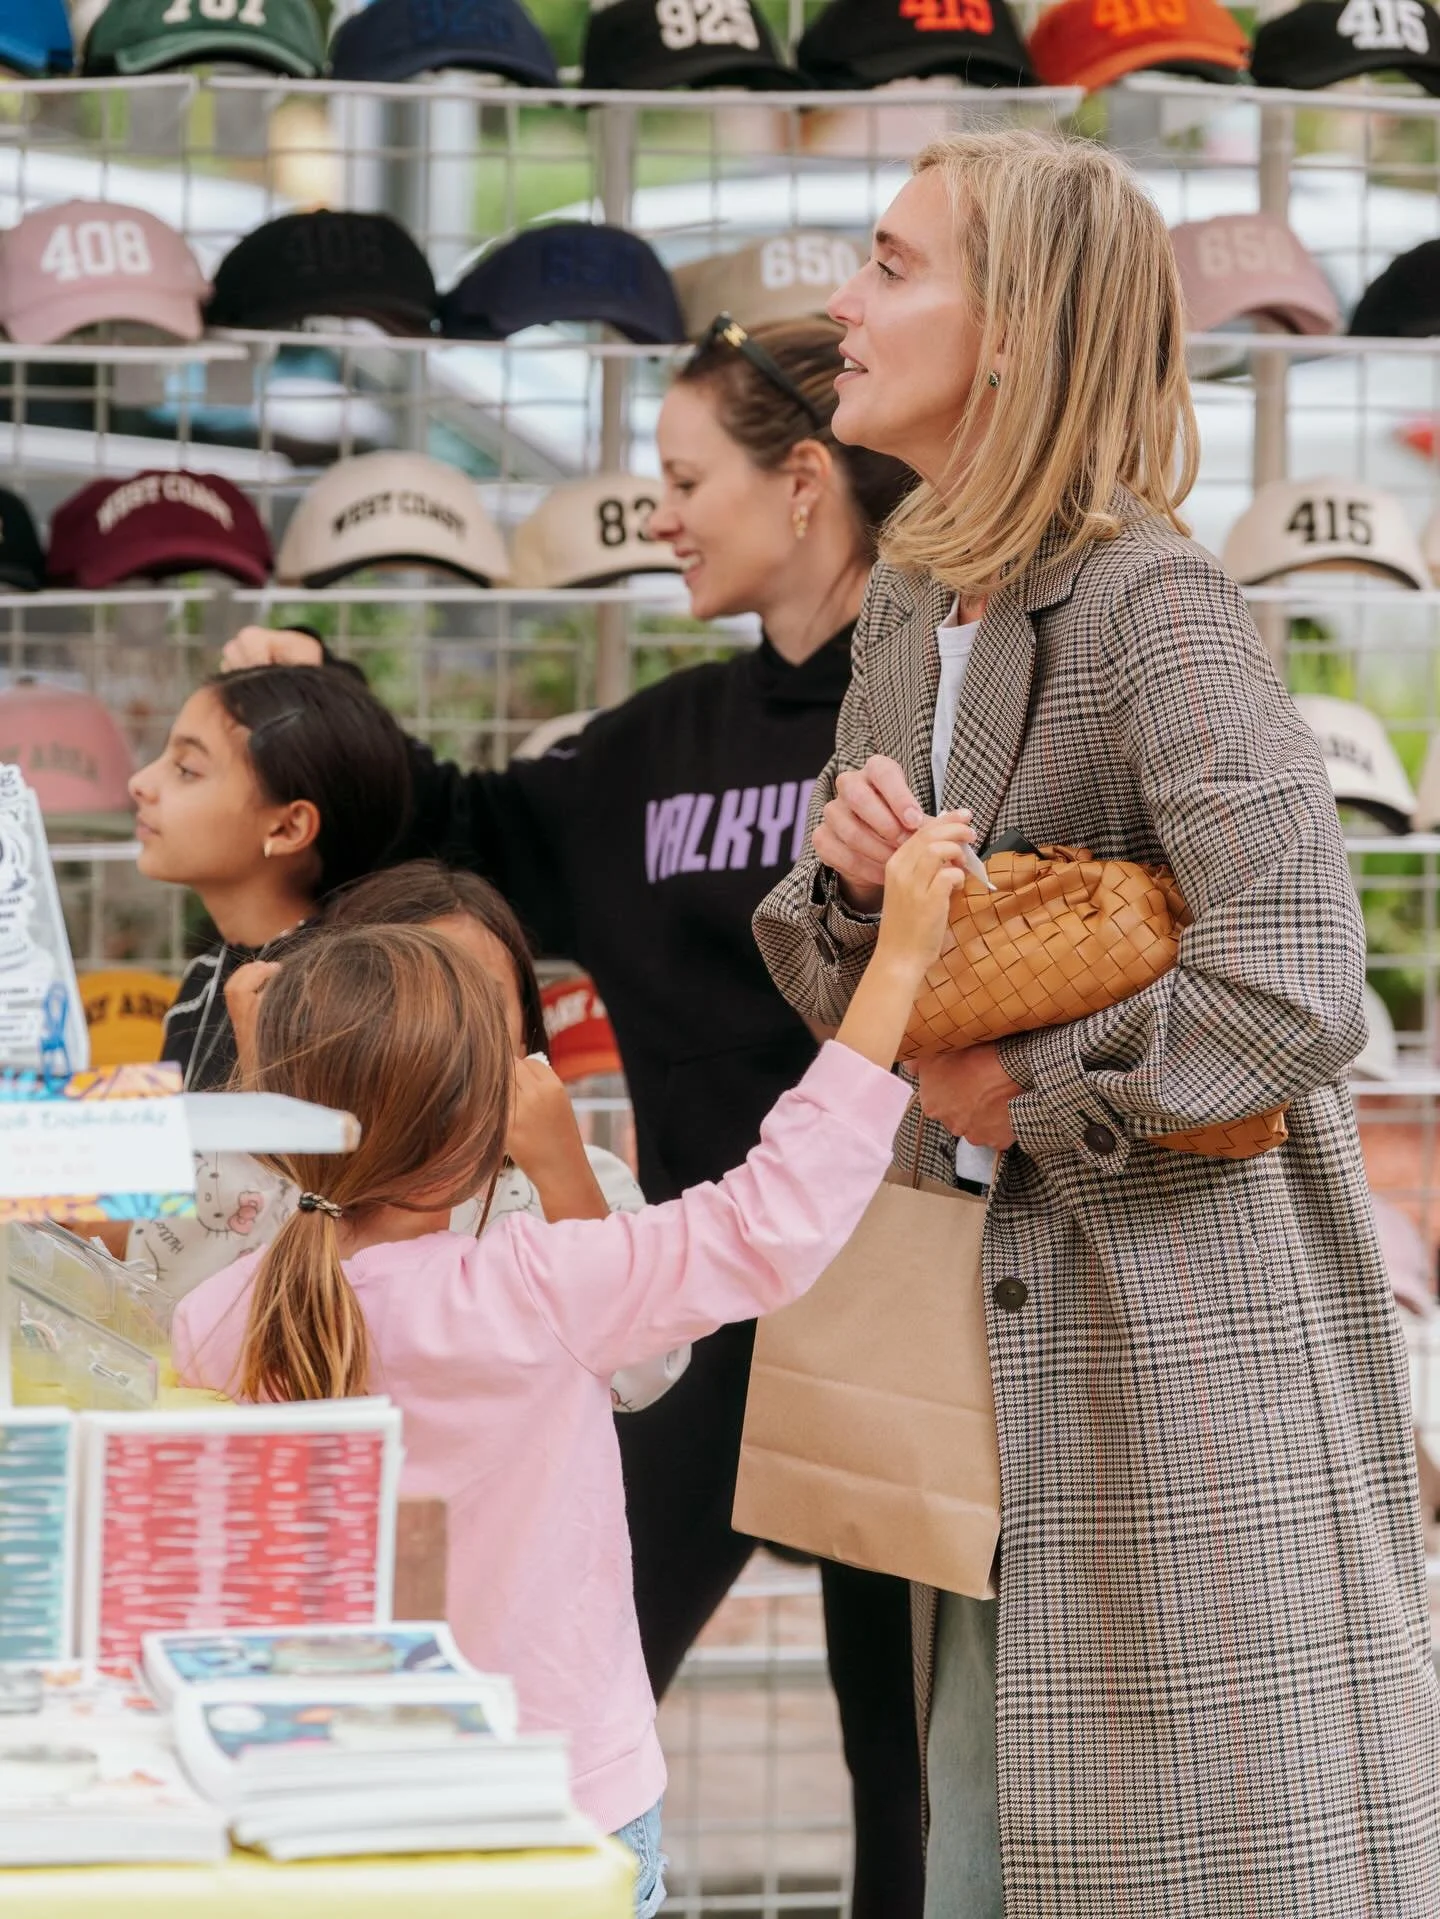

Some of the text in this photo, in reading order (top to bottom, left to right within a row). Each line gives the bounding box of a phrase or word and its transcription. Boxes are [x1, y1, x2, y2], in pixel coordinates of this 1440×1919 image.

[1336, 0, 1430, 55] 415
[39, 219, 155, 284] 408
[762, 235, 860, 290] 650
[1197, 224, 1297, 278] 650
[1286, 495, 1374, 547] 415
